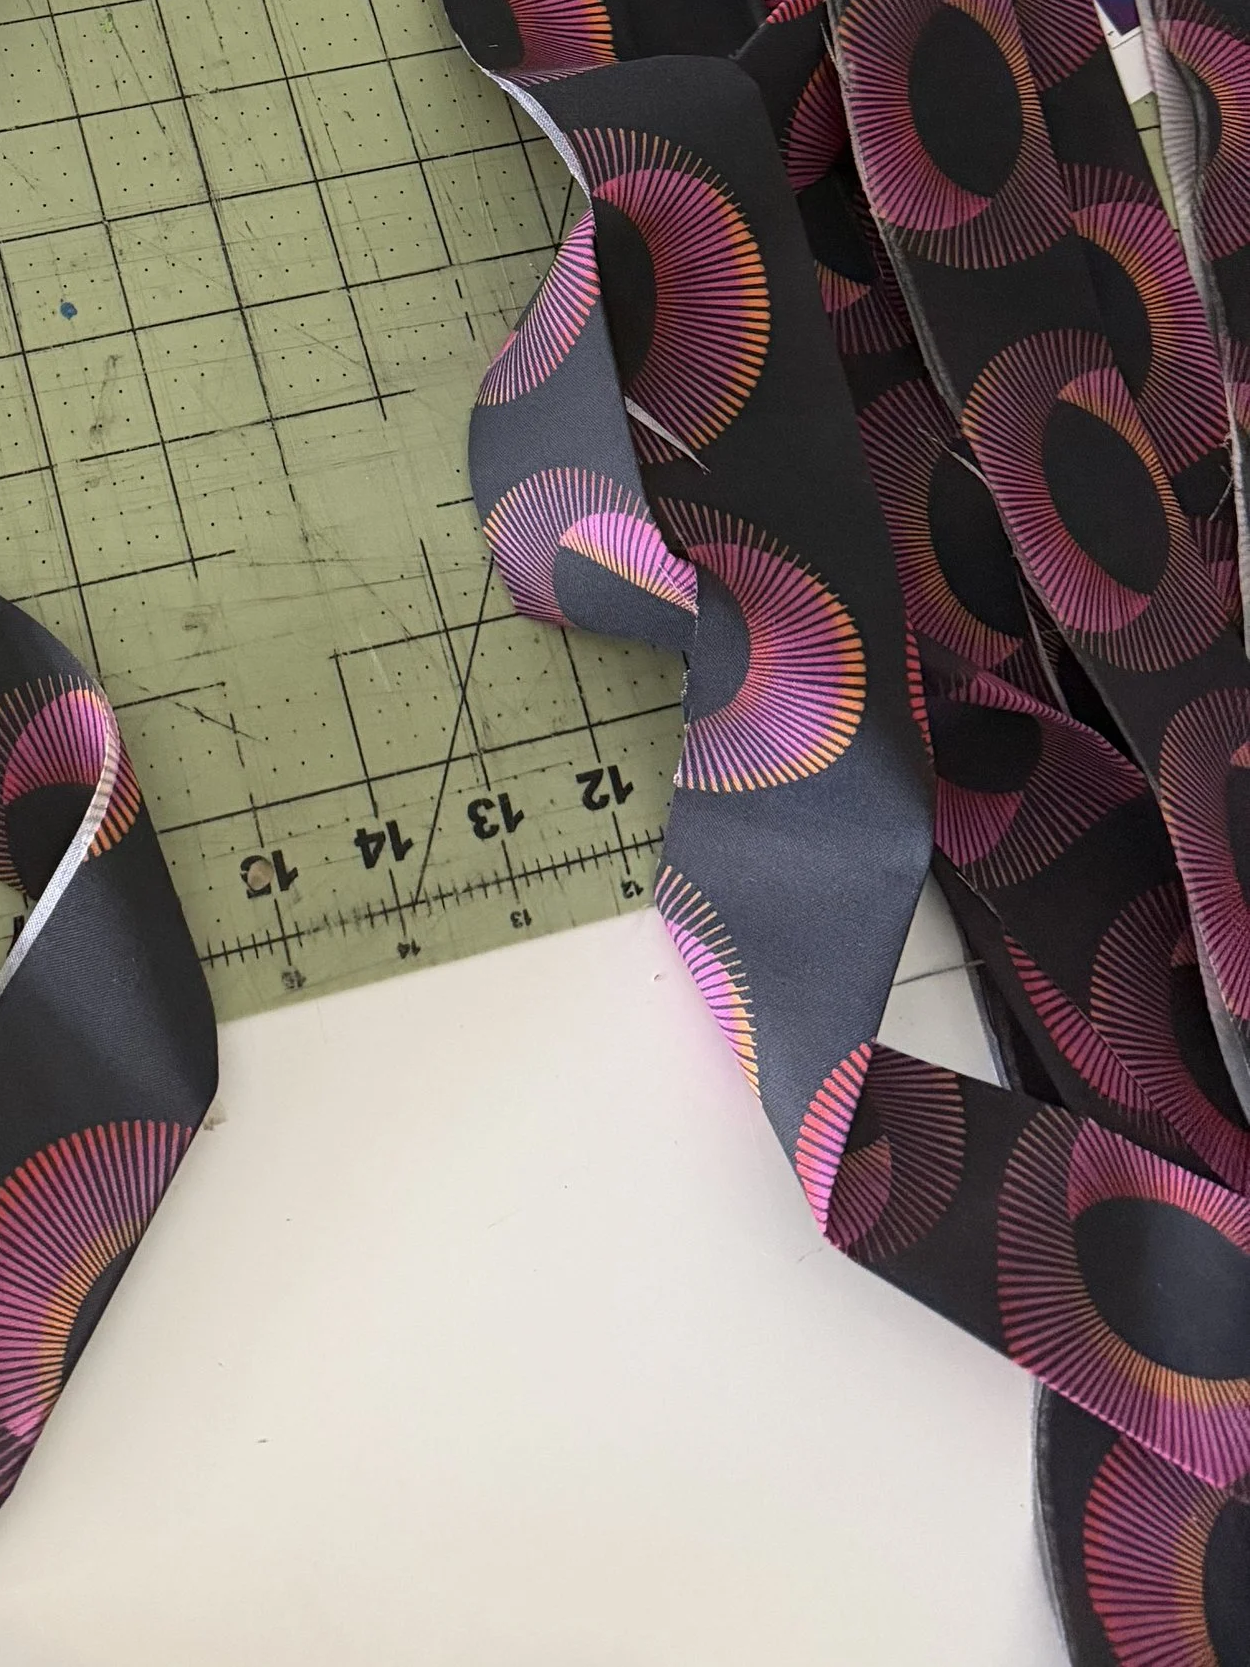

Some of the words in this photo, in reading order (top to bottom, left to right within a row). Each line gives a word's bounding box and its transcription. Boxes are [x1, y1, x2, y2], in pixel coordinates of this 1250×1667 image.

[575, 764, 634, 812] 12
[466, 792, 525, 840] 13
[354, 820, 414, 869] 14
[620, 880, 643, 900] 12
[510, 909, 533, 930] 13
[397, 941, 421, 960] 14
